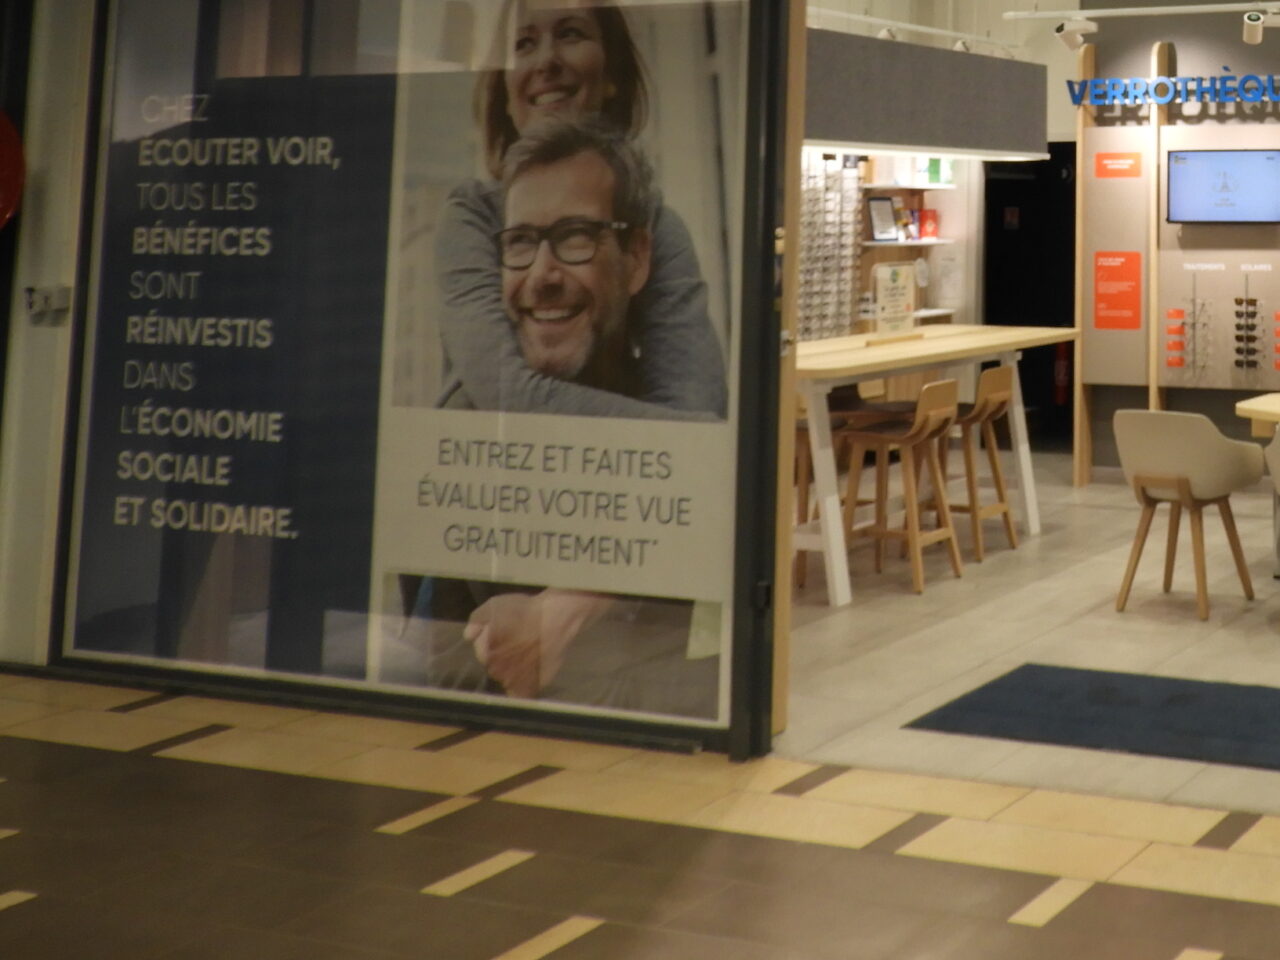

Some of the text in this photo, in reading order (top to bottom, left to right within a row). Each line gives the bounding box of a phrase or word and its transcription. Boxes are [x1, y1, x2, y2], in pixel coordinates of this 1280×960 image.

[265, 136, 341, 170] VOIR,
[136, 182, 258, 211] TOUS LES
[131, 220, 274, 256] BÉNÉFICES
[129, 271, 203, 300] SONT
[126, 309, 275, 348] RÉINVESTIS
[122, 360, 196, 391] DANS
[120, 399, 284, 442] L'ÉCONOMIE
[116, 450, 232, 486] SOCIALE
[437, 438, 673, 480] ENTREZ ET FAITES
[114, 495, 299, 539] ET SOLIDAIRE.
[417, 473, 692, 526] ÉVALUER VOTRE VUE
